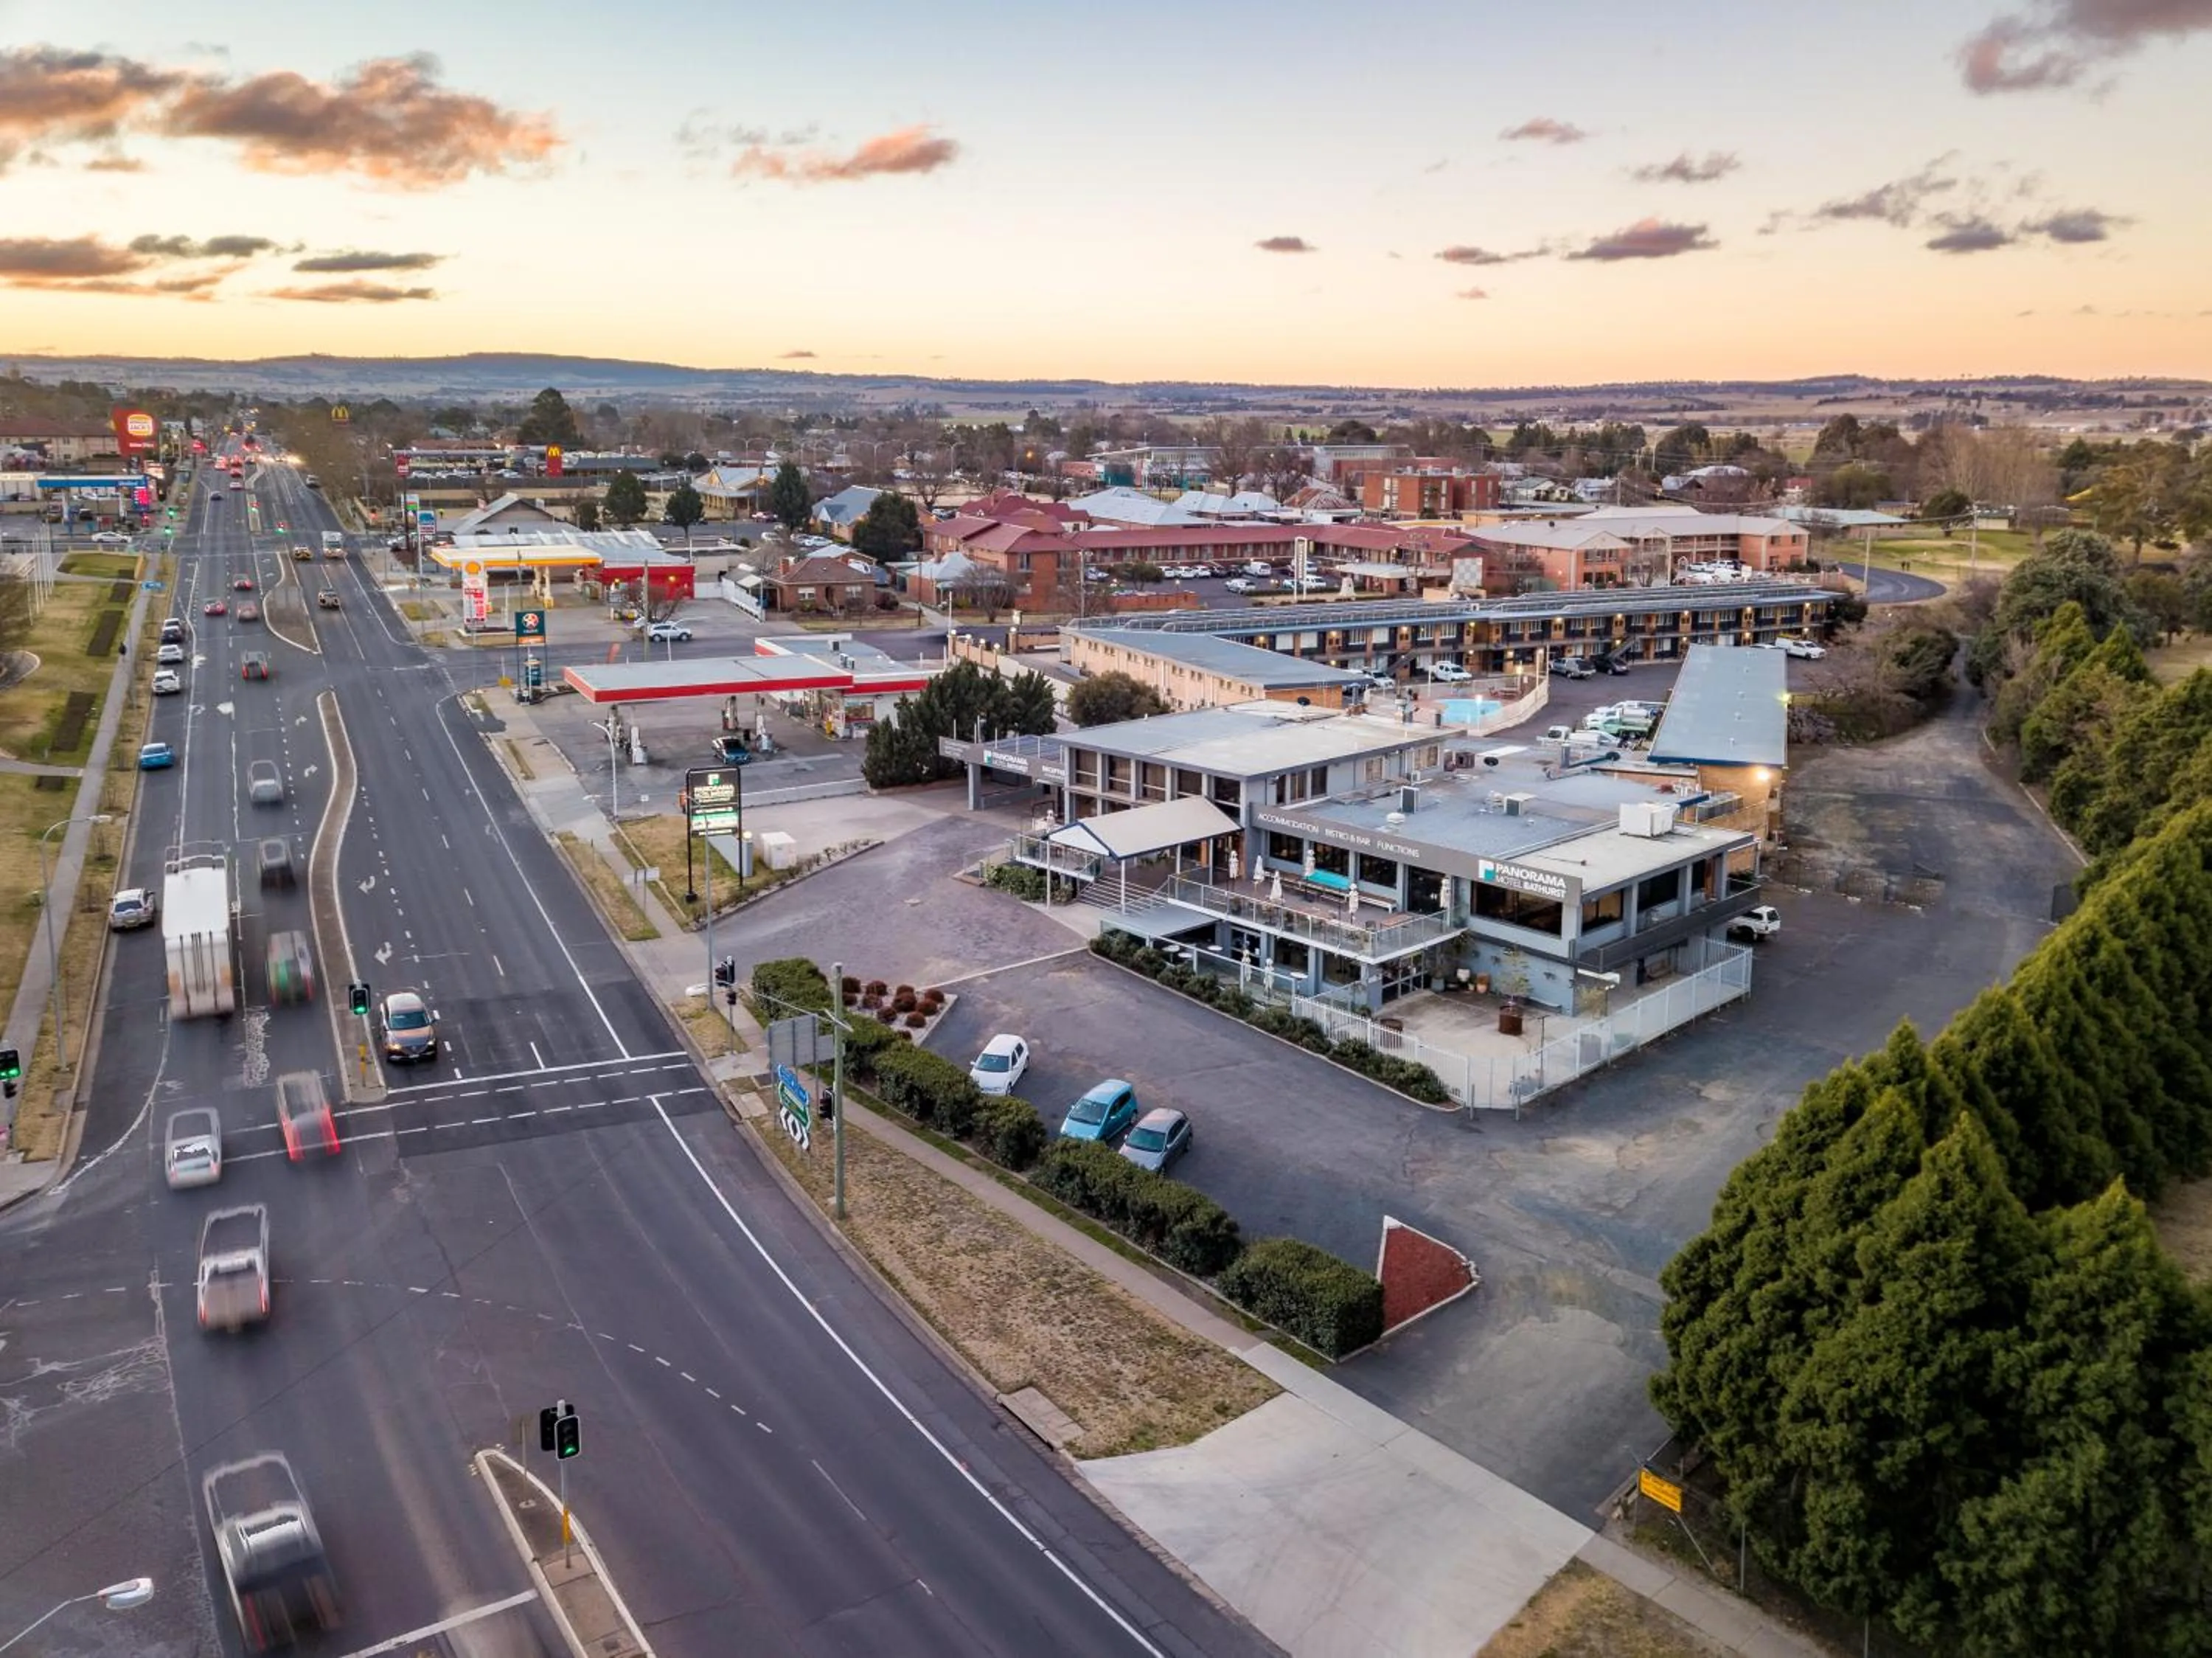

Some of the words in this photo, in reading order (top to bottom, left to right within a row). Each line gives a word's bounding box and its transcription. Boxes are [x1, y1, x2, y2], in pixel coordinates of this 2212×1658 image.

[1257, 813, 1319, 833] ACCOMMODATION
[1325, 828, 1349, 842] BISTRO
[1356, 834, 1371, 847] BAR
[1377, 840, 1419, 859] FUNCTIONS
[1496, 862, 1567, 889] PANORAMA
[1497, 875, 1523, 889] MOTEL
[1523, 881, 1568, 898] BATHURST
